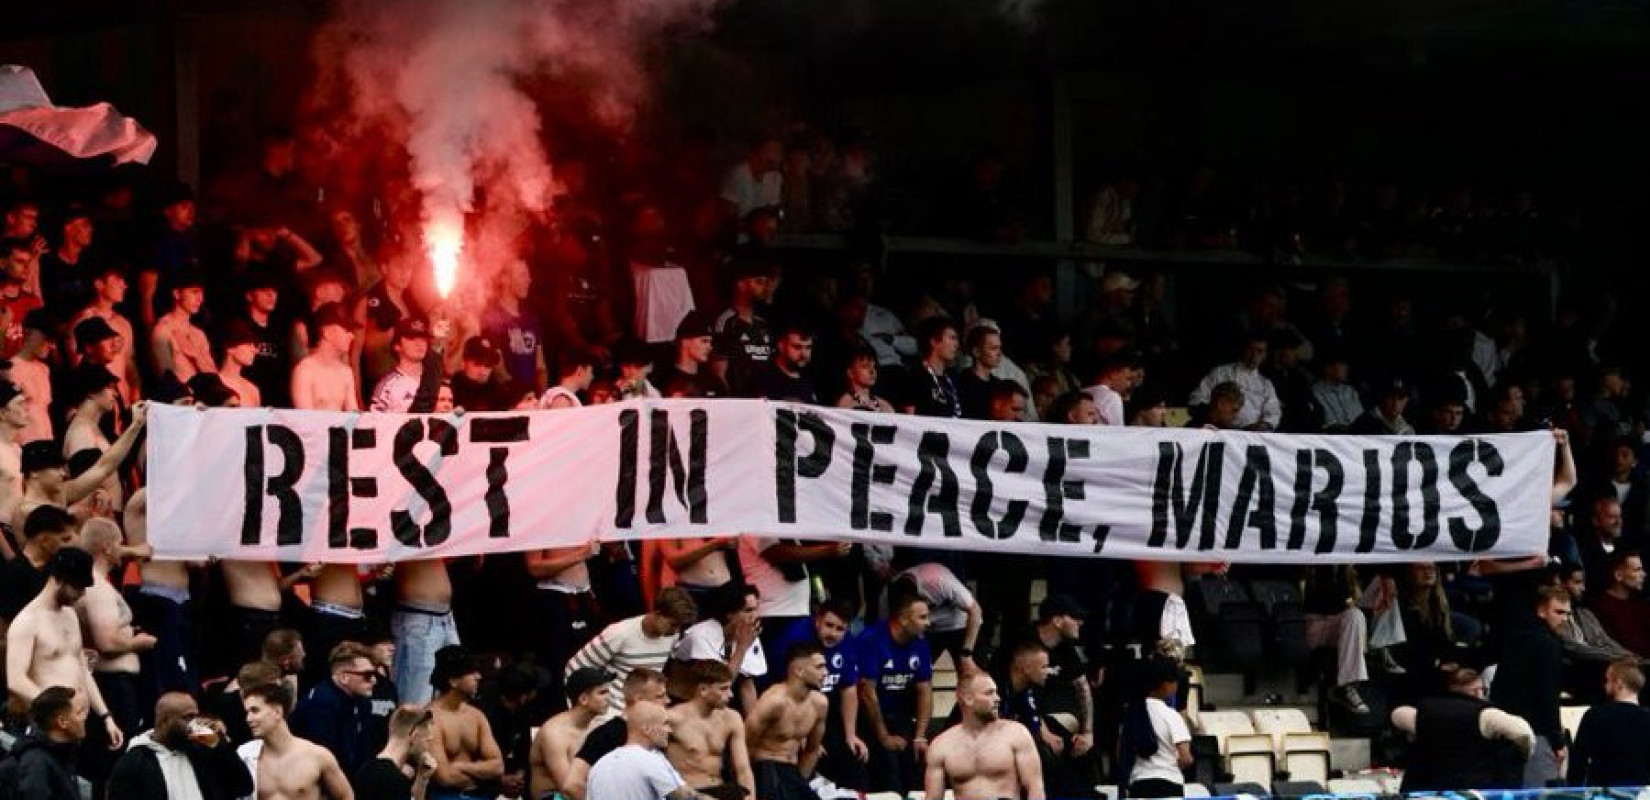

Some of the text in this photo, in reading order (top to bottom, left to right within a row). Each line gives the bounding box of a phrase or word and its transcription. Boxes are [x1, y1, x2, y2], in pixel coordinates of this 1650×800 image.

[240, 408, 1504, 554] REST IN PEACE, MARIOS
